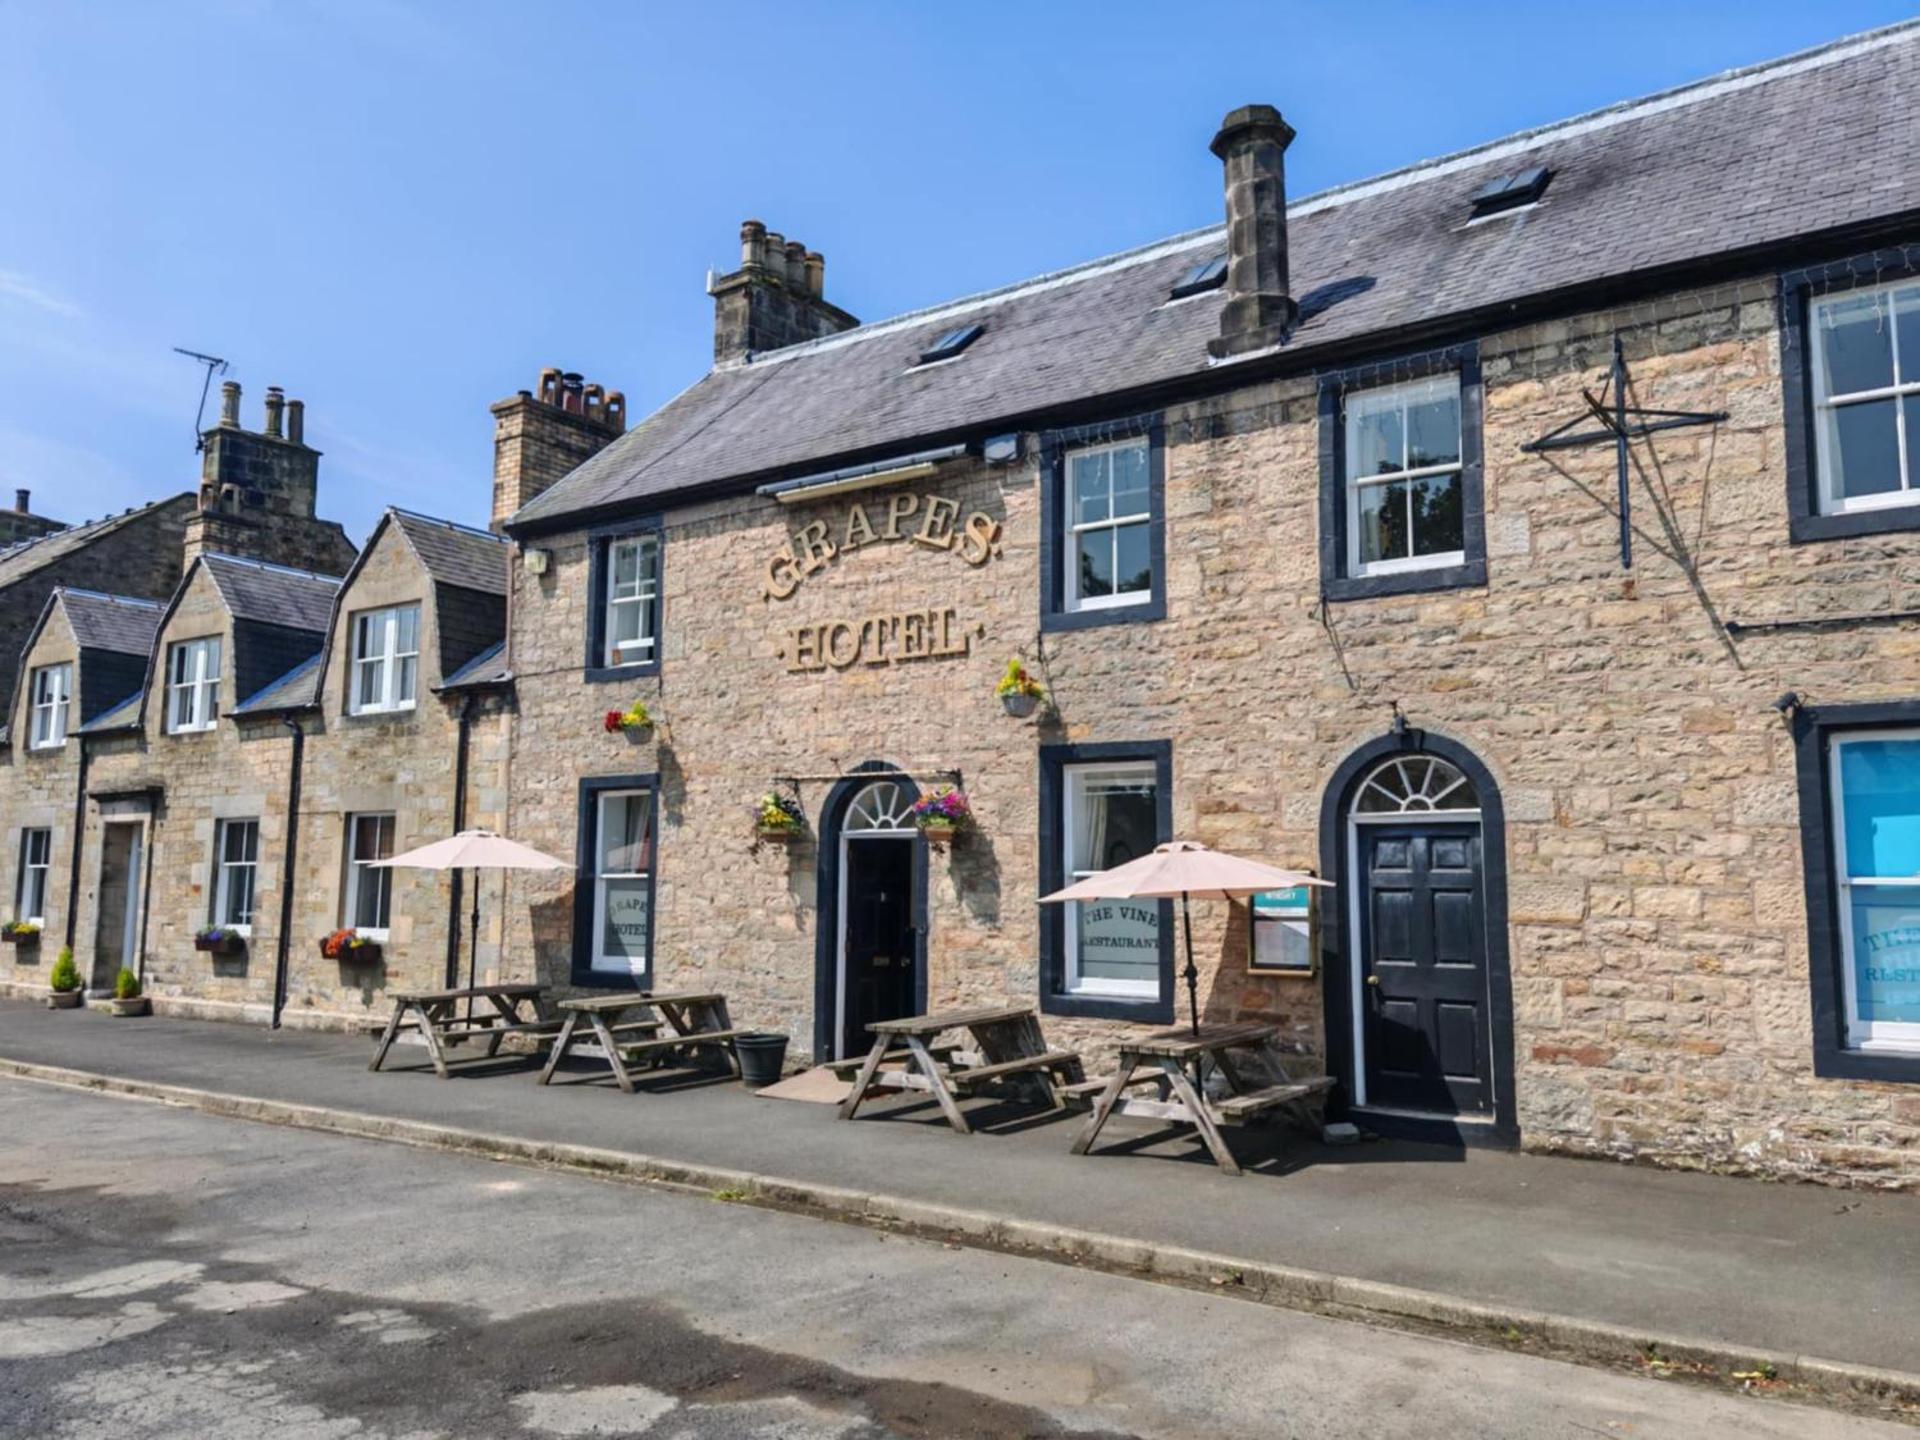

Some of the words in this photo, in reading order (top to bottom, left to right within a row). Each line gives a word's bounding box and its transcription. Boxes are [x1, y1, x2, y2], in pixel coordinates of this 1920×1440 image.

[765, 492, 999, 599] GRAPES
[787, 608, 969, 673] HOTEL
[1119, 906, 1158, 927] VINE
